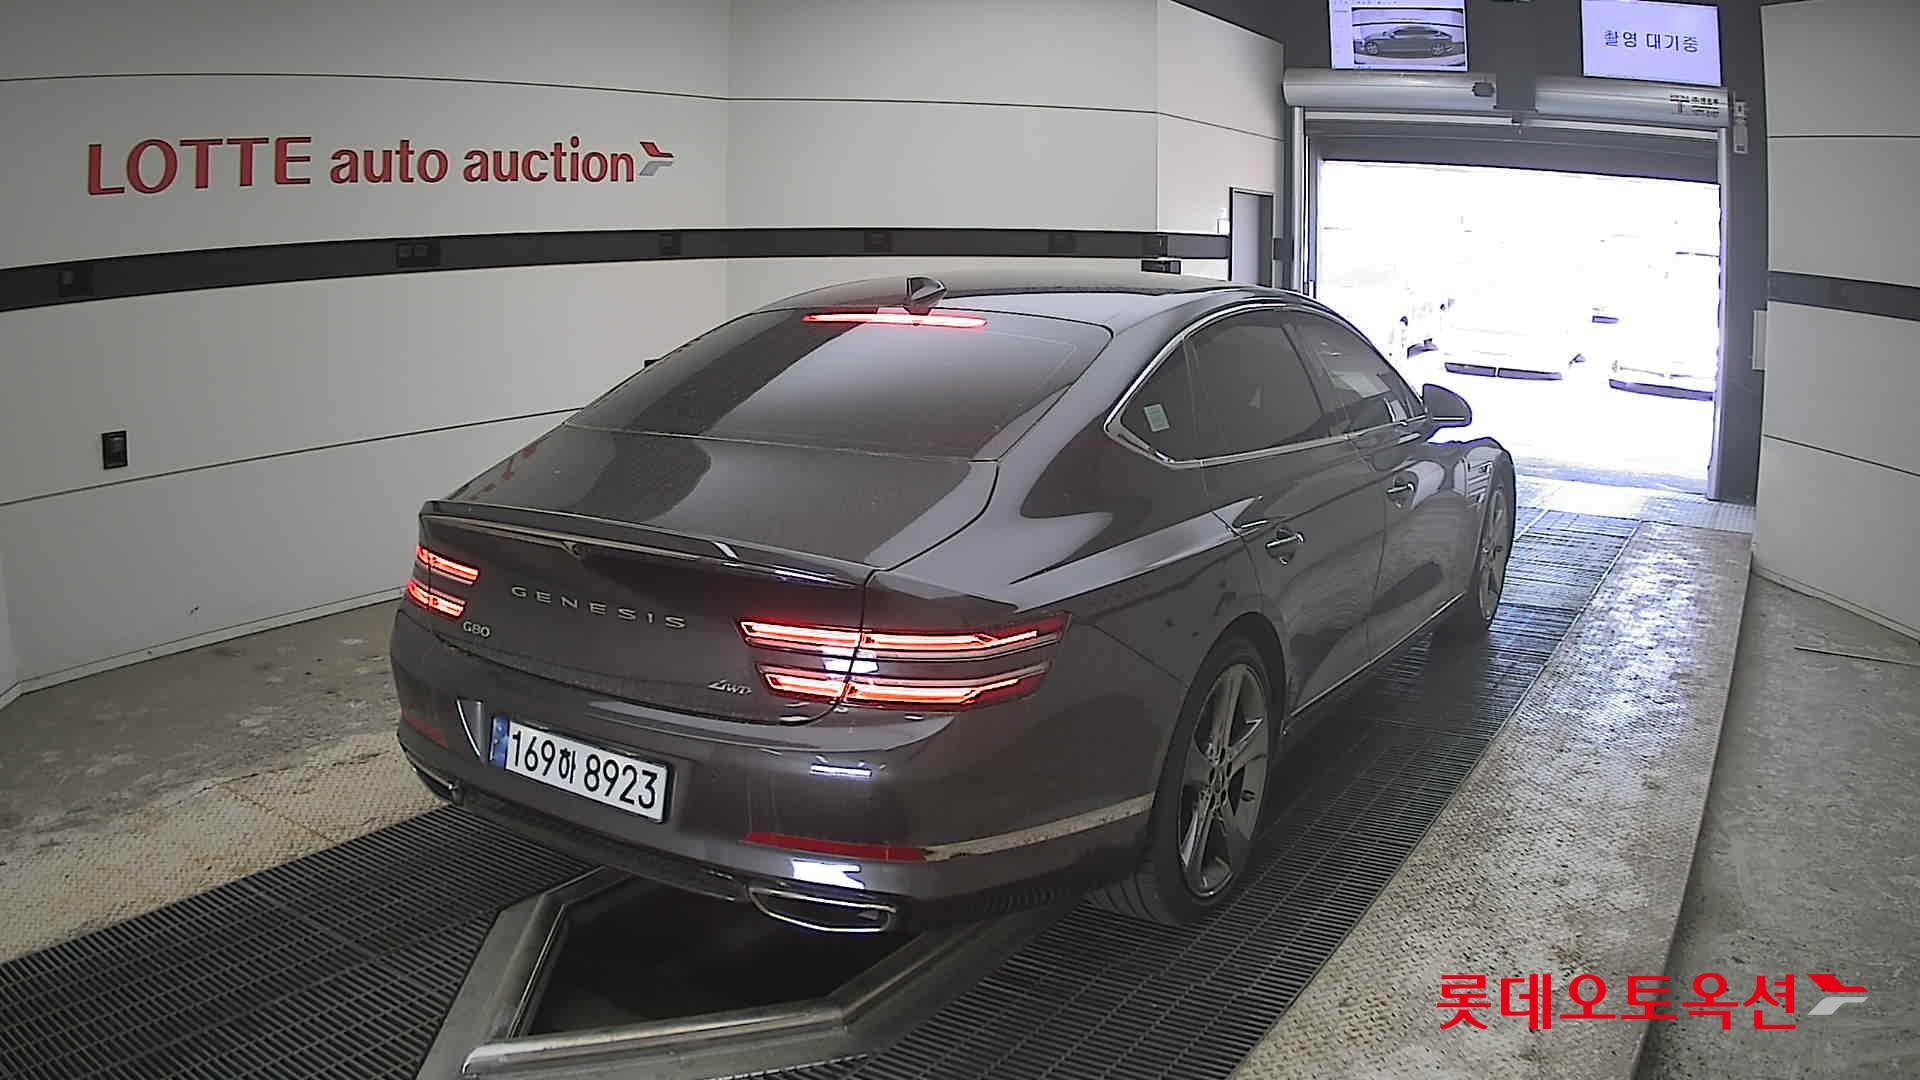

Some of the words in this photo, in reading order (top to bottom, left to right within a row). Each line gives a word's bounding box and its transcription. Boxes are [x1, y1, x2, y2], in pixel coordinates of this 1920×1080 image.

[1646, 33, 1698, 53] 대기중
[88, 137, 311, 195] LOTTE
[330, 139, 448, 183] auto
[463, 136, 635, 183] auction
[463, 620, 490, 638] G80
[511, 586, 687, 630] GENESIS
[512, 730, 576, 784] 169하
[584, 753, 658, 809] 8923
